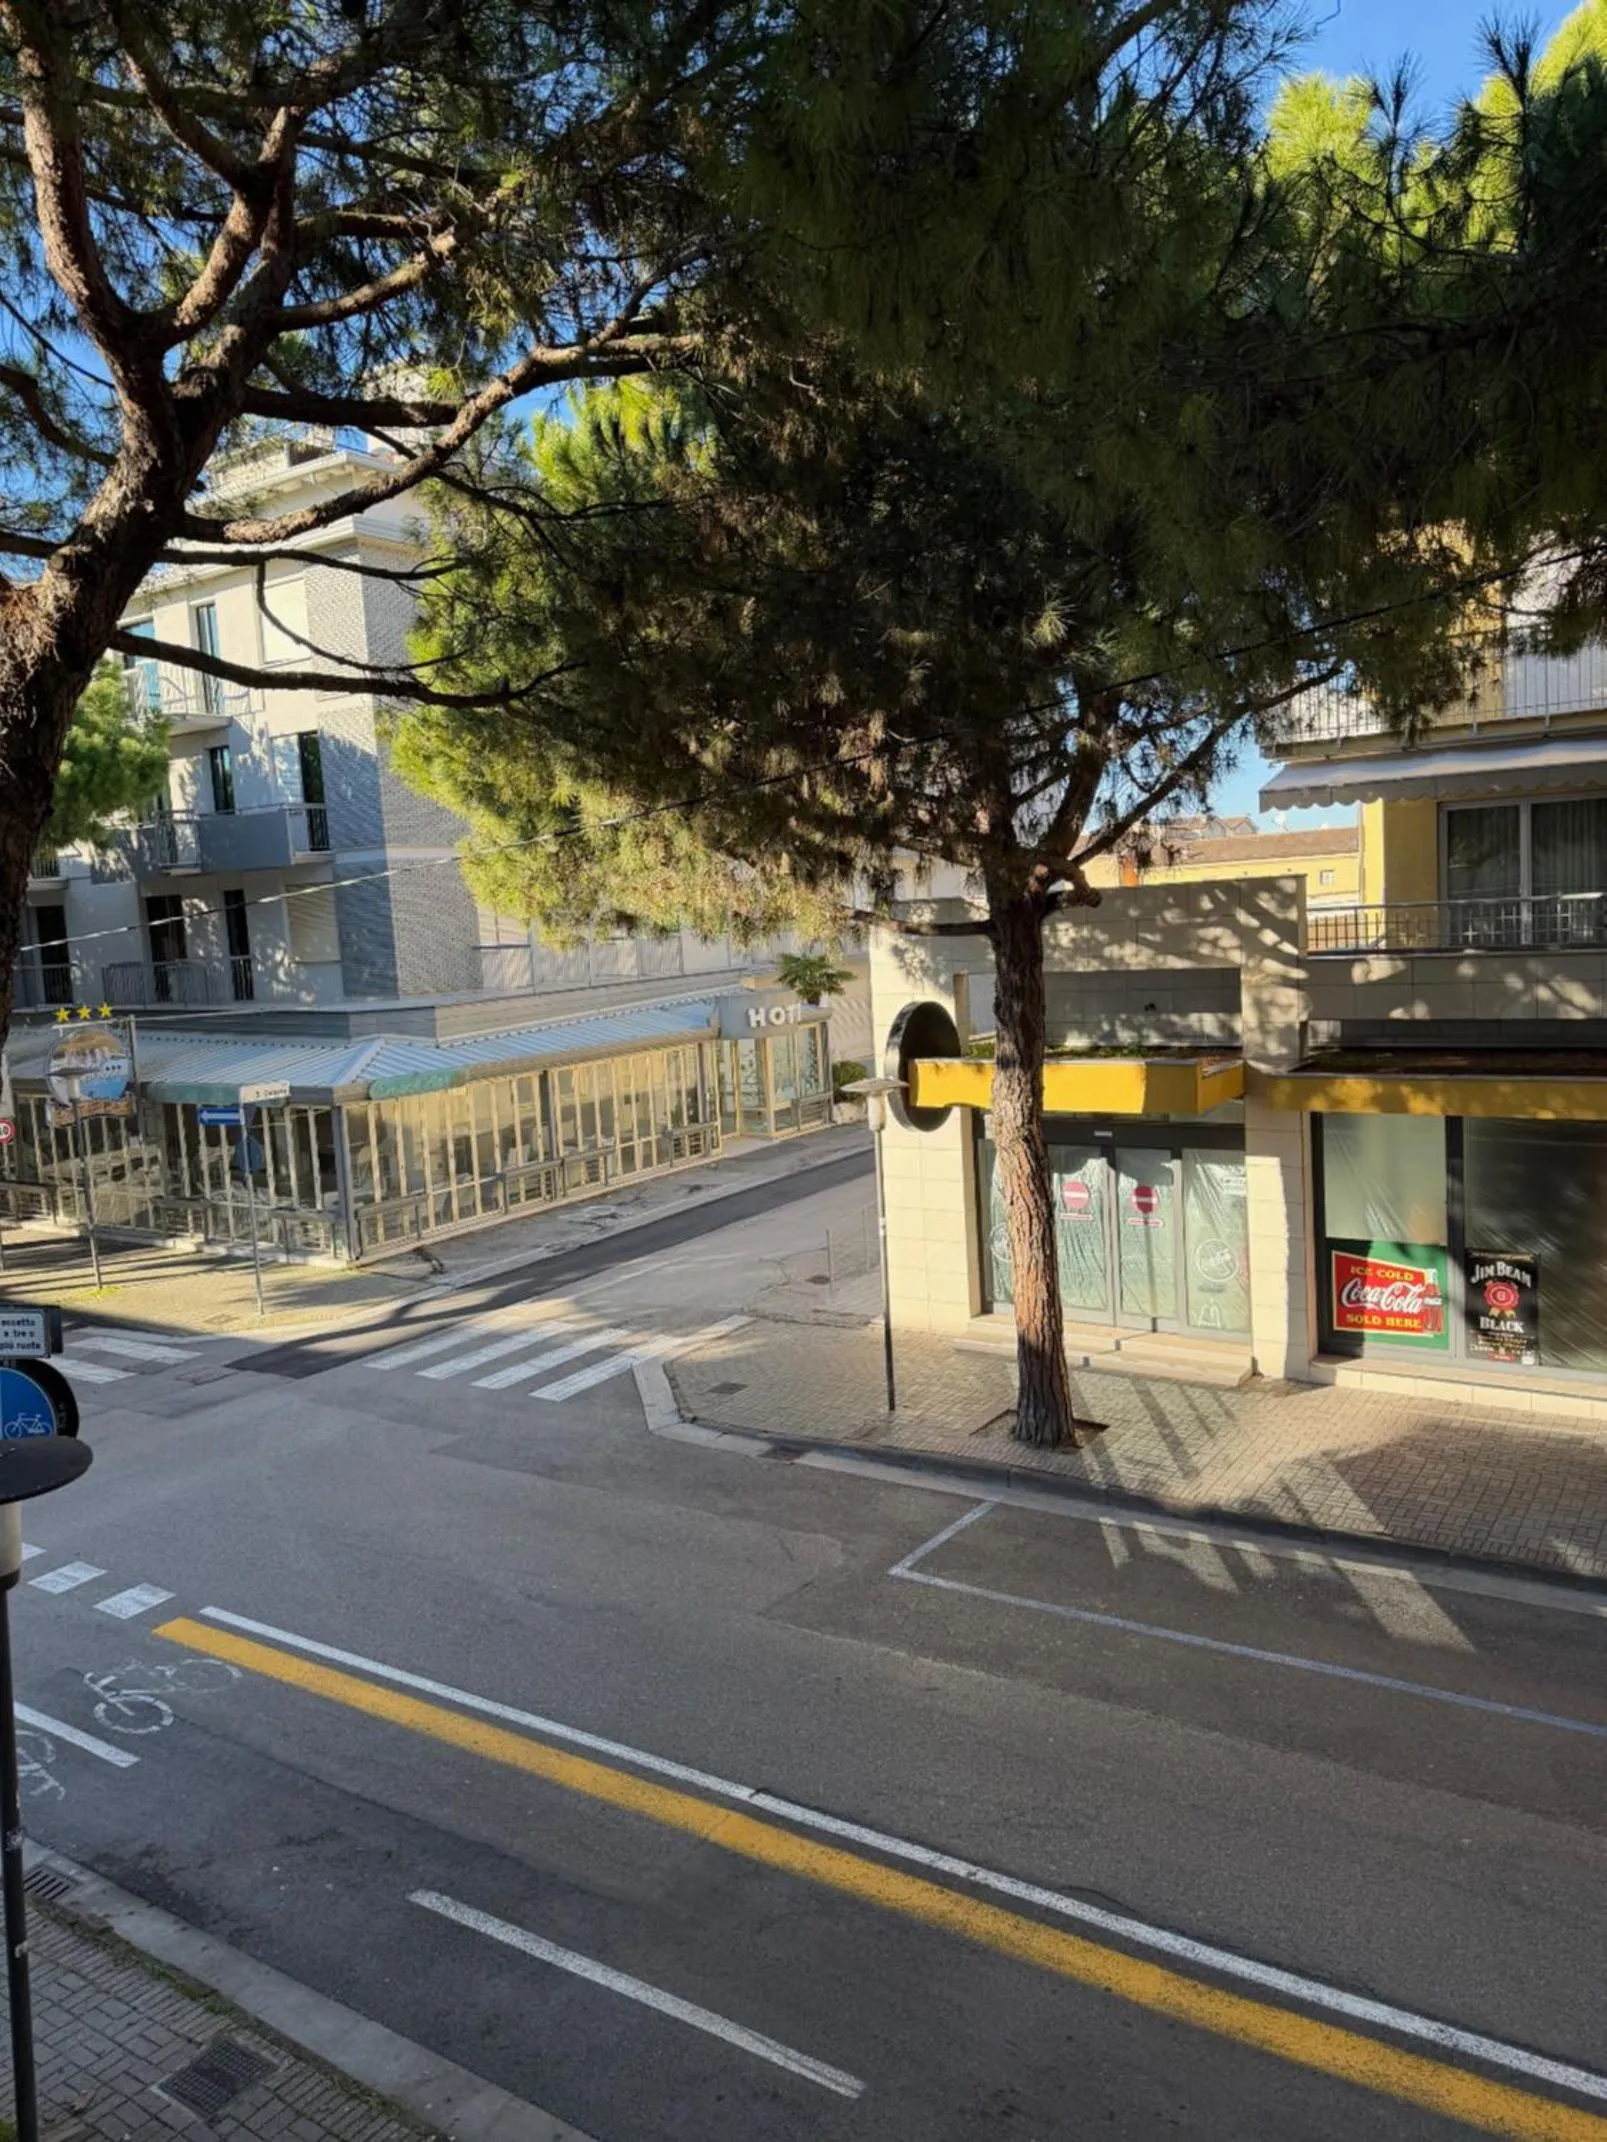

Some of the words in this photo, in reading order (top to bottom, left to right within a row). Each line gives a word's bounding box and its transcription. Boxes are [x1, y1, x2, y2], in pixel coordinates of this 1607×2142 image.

[748, 1003, 800, 1028] HOT
[1350, 1265, 1373, 1276] ICE
[1376, 1269, 1414, 1281] COLD
[1471, 1264, 1495, 1284] JIM
[1496, 1261, 1532, 1288] BEAM
[1341, 1277, 1425, 1314] Coca-Cola
[1345, 1313, 1382, 1325] SOLD
[1385, 1317, 1422, 1329] HERE
[1480, 1316, 1525, 1334] BLACK
